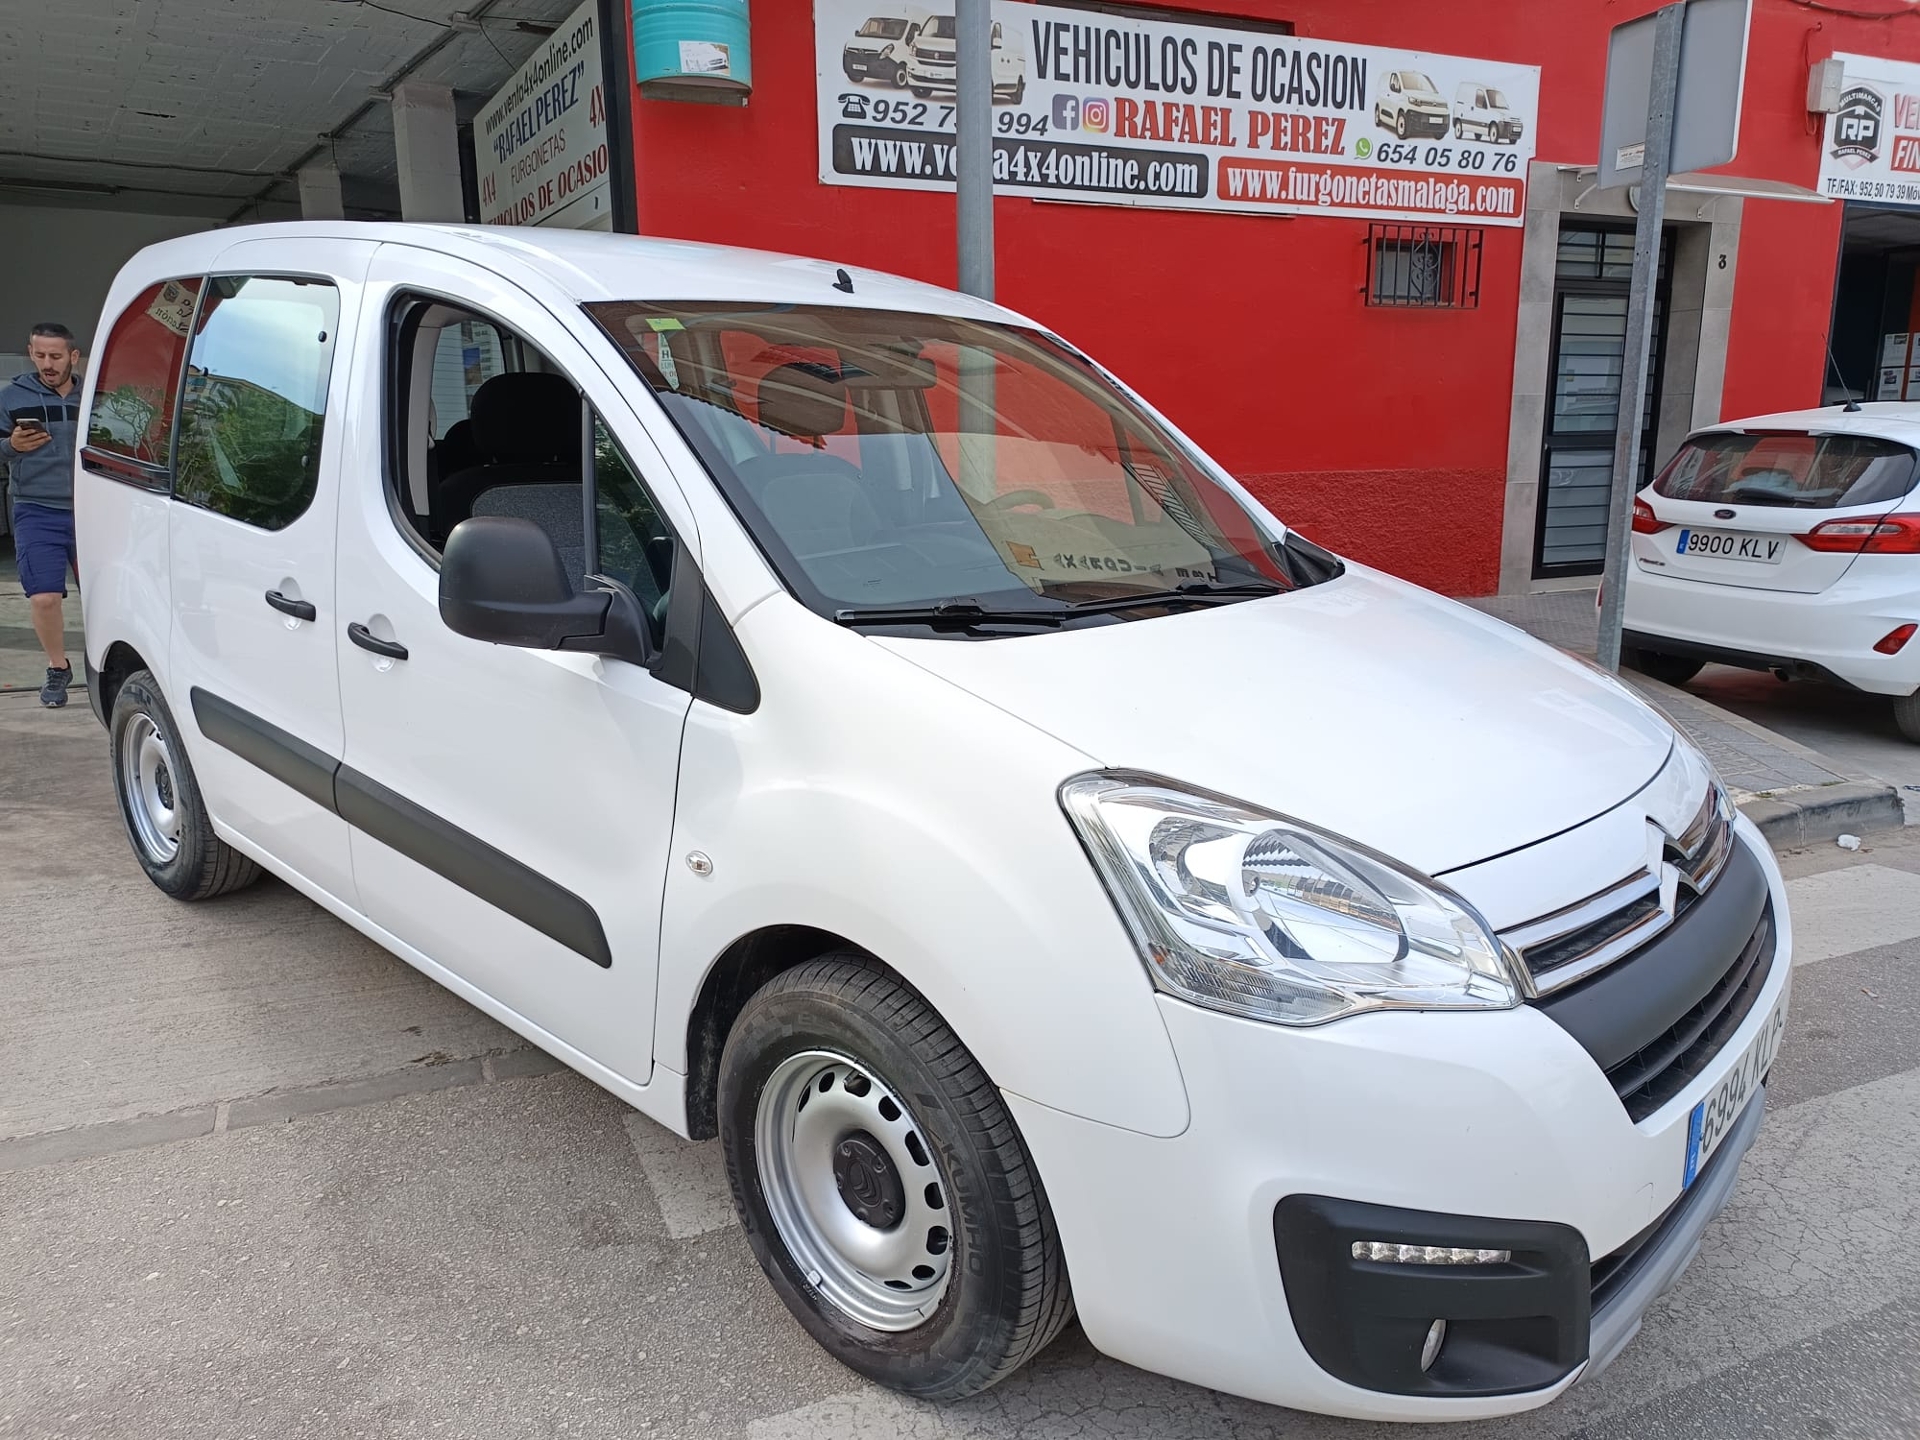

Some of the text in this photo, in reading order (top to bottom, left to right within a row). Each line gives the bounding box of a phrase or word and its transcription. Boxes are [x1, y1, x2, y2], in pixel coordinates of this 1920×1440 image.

[1032, 19, 1367, 111] VEHICULOS DE OCASION
[871, 99, 927, 127] 952
[997, 111, 1048, 137] 994
[1114, 97, 1346, 156] RAFAEL PEREZ
[1841, 117, 1875, 141] RP
[1895, 94, 1920, 130] VE
[511, 128, 567, 188] FURGONETAS
[1376, 143, 1518, 173] 654 05 80 76
[538, 179, 555, 212] DE
[1226, 166, 1515, 214] www.furgonetasmalaga.com
[1718, 253, 1727, 270] 3
[1688, 533, 1780, 560] 9900 KLV
[1702, 1052, 1750, 1154] 6994
[941, 1142, 986, 1276] KUMHO
